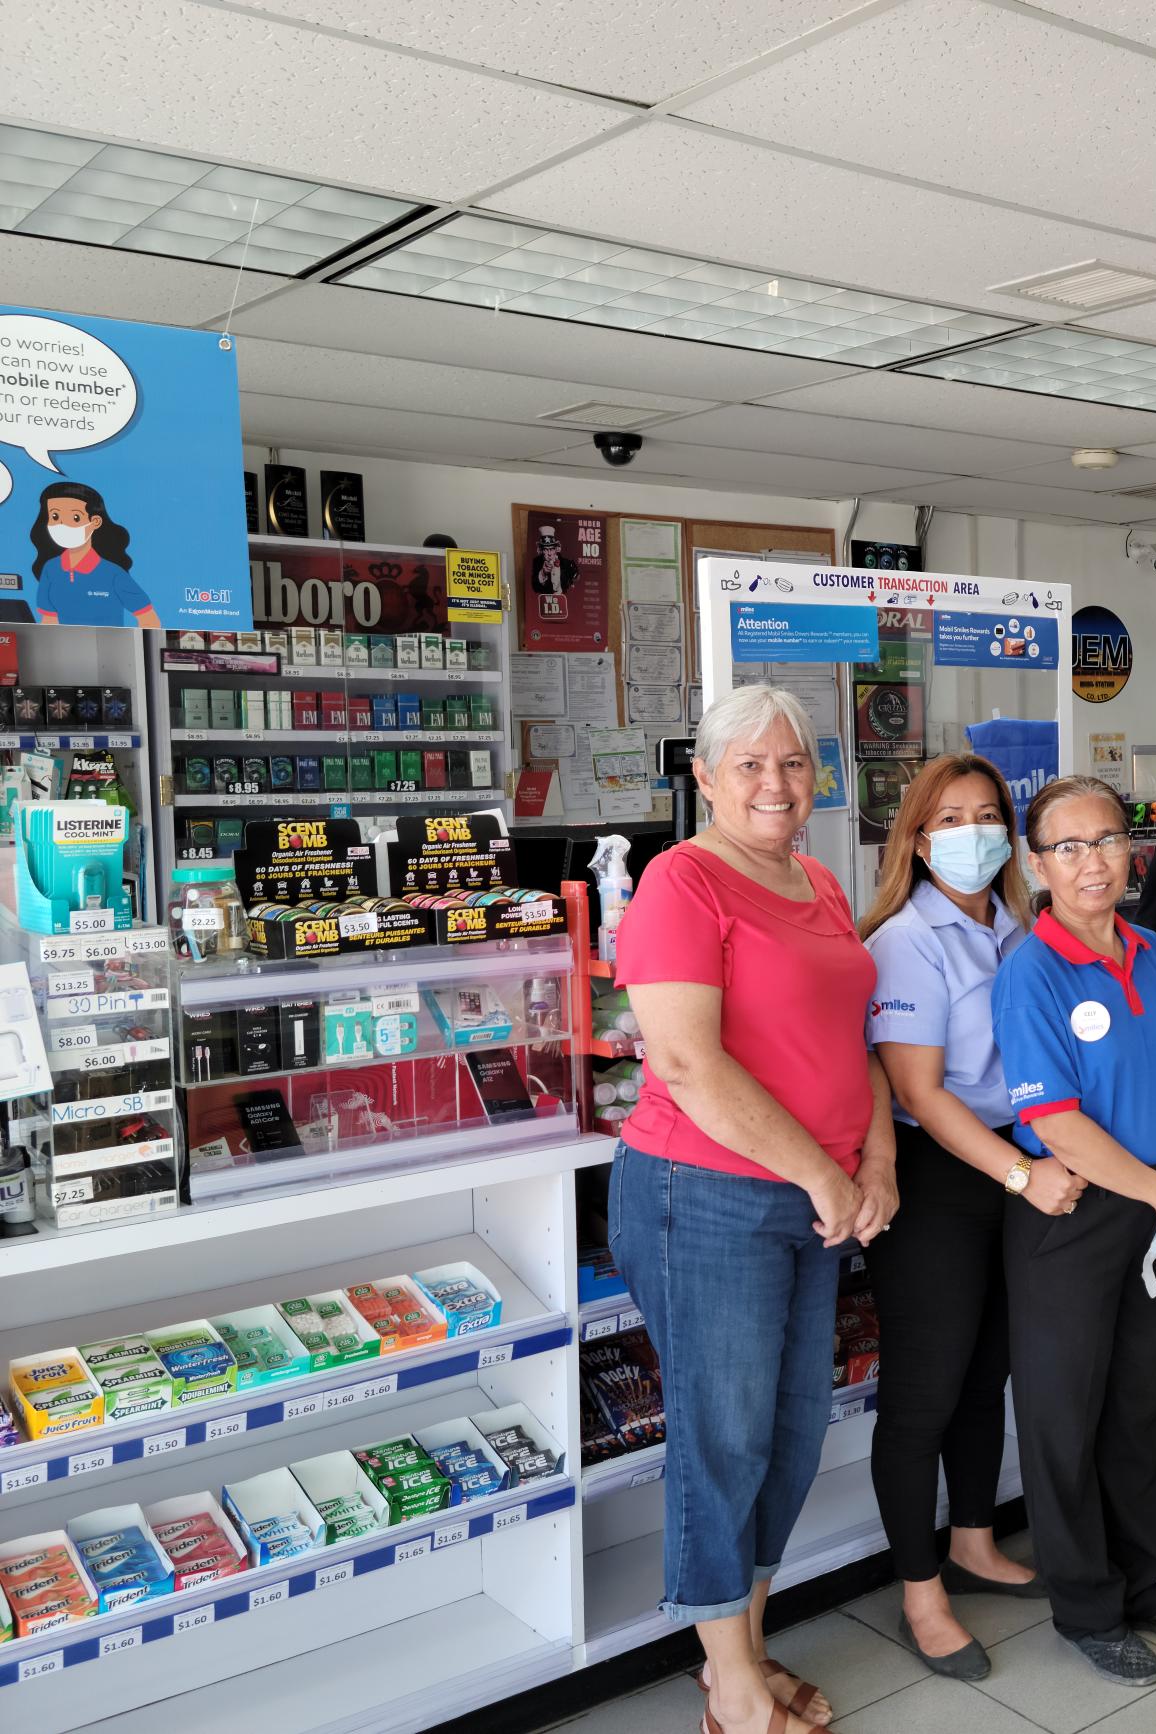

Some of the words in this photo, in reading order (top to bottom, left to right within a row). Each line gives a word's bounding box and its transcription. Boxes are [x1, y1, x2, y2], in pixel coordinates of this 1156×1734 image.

[17, 338, 85, 357] worries!
[1, 356, 31, 368] can
[37, 360, 74, 373] now
[79, 365, 108, 378] use
[20, 395, 38, 406] or
[27, 414, 95, 431] rewards
[578, 528, 601, 542] AGE
[582, 543, 600, 557] NO
[457, 563, 489, 572] TOBACCO
[461, 557, 486, 566] BUYING
[453, 578, 476, 586] COULD
[468, 572, 495, 580] MINORS
[813, 573, 875, 590] CUSTOMER
[878, 577, 948, 593] TRANSACTION
[953, 582, 980, 595] AREA
[185, 588, 231, 603] Mobil
[249, 560, 381, 628] lboro
[545, 595, 558, 604] We
[188, 608, 222, 616] ExxonMobil
[544, 603, 562, 614] I.D.
[738, 618, 789, 630] Attention
[1098, 692, 1110, 700] LTD.
[229, 782, 260, 794] $8.95
[391, 781, 415, 791] $7.25
[57, 819, 122, 832] LISTERINE
[278, 822, 326, 836] SCENT
[425, 817, 468, 830] SCENT
[64, 829, 90, 839] COOL
[92, 829, 115, 838] MINT
[183, 848, 213, 859] $8.45
[452, 854, 496, 862] FRESHNESS!
[305, 862, 353, 870] FRESHNESS!
[383, 913, 411, 921] LASTING
[447, 908, 487, 921] SCENT
[525, 909, 547, 920] $3.50
[75, 920, 106, 930] $5.00
[295, 919, 338, 932] SCENT
[344, 923, 370, 934] $3.50
[393, 919, 419, 927] SCENTS
[520, 924, 550, 932] DURABLES
[386, 927, 425, 937] PUISSANTES
[132, 940, 166, 950] $13.00
[375, 936, 411, 945] DURABLES
[43, 948, 75, 960] $9.75
[86, 947, 117, 958] $6.00
[55, 981, 88, 991] $13.25
[68, 997, 91, 1014] 30
[97, 995, 126, 1012] Pin
[58, 1035, 91, 1048] $8.00
[84, 1055, 116, 1068] $6.00
[477, 1061, 511, 1070] SAMSUNG
[480, 1068, 504, 1077] Galaxy
[53, 1104, 106, 1122] Micro
[245, 1103, 281, 1113] SAMSUNG
[247, 1111, 273, 1119] Galaxy
[54, 1188, 85, 1203] $7.25
[58, 1209, 82, 1223] Car
[89, 1198, 146, 1218] Charger
[459, 1314, 490, 1335] Extra
[622, 1316, 645, 1328] $1.25
[589, 1325, 611, 1336] $1.25
[159, 1338, 208, 1352] DOUBLEMINT
[88, 1346, 148, 1364] SPEARMINT
[482, 1352, 506, 1365] $1.55
[30, 1363, 65, 1377] Juicy
[171, 1354, 229, 1373] Winterfresh
[33, 1369, 68, 1382] Fruit
[104, 1368, 161, 1387] SPEARMINT
[189, 1369, 221, 1382] Winterfresh
[601, 1364, 640, 1383] Pocky
[181, 1382, 230, 1402] DOUBLEMINT
[34, 1390, 94, 1412] SPEARMINT
[113, 1400, 163, 1419] SPEARMINT
[288, 1403, 316, 1417] $1.60
[843, 1406, 861, 1418] $1.30
[43, 1422, 71, 1435] Juicy
[72, 1416, 97, 1429] Fruit
[210, 1423, 239, 1438] $1.50
[149, 1439, 178, 1454] $1.50
[73, 1458, 105, 1473] $1.50
[388, 1455, 418, 1470] ICE
[449, 1458, 478, 1473] ICE
[519, 1458, 547, 1473] ICE
[400, 1469, 430, 1481] Dentyne
[402, 1474, 433, 1489] ICE
[7, 1474, 39, 1490] $1.50
[462, 1476, 491, 1491] ICE
[497, 1514, 521, 1528] $1.65
[438, 1531, 463, 1544] $1.65
[399, 1546, 424, 1561] $1.65
[183, 1569, 220, 1589] Trident
[319, 1570, 346, 1585] $1.60
[13, 1574, 60, 1598] Trident
[107, 1586, 149, 1609] Trident
[254, 1591, 282, 1607] $1.60
[31, 1614, 70, 1634] Trident
[178, 1615, 207, 1630] $1.60
[104, 1638, 134, 1653] $1.60
[24, 1662, 55, 1678] $1.60
